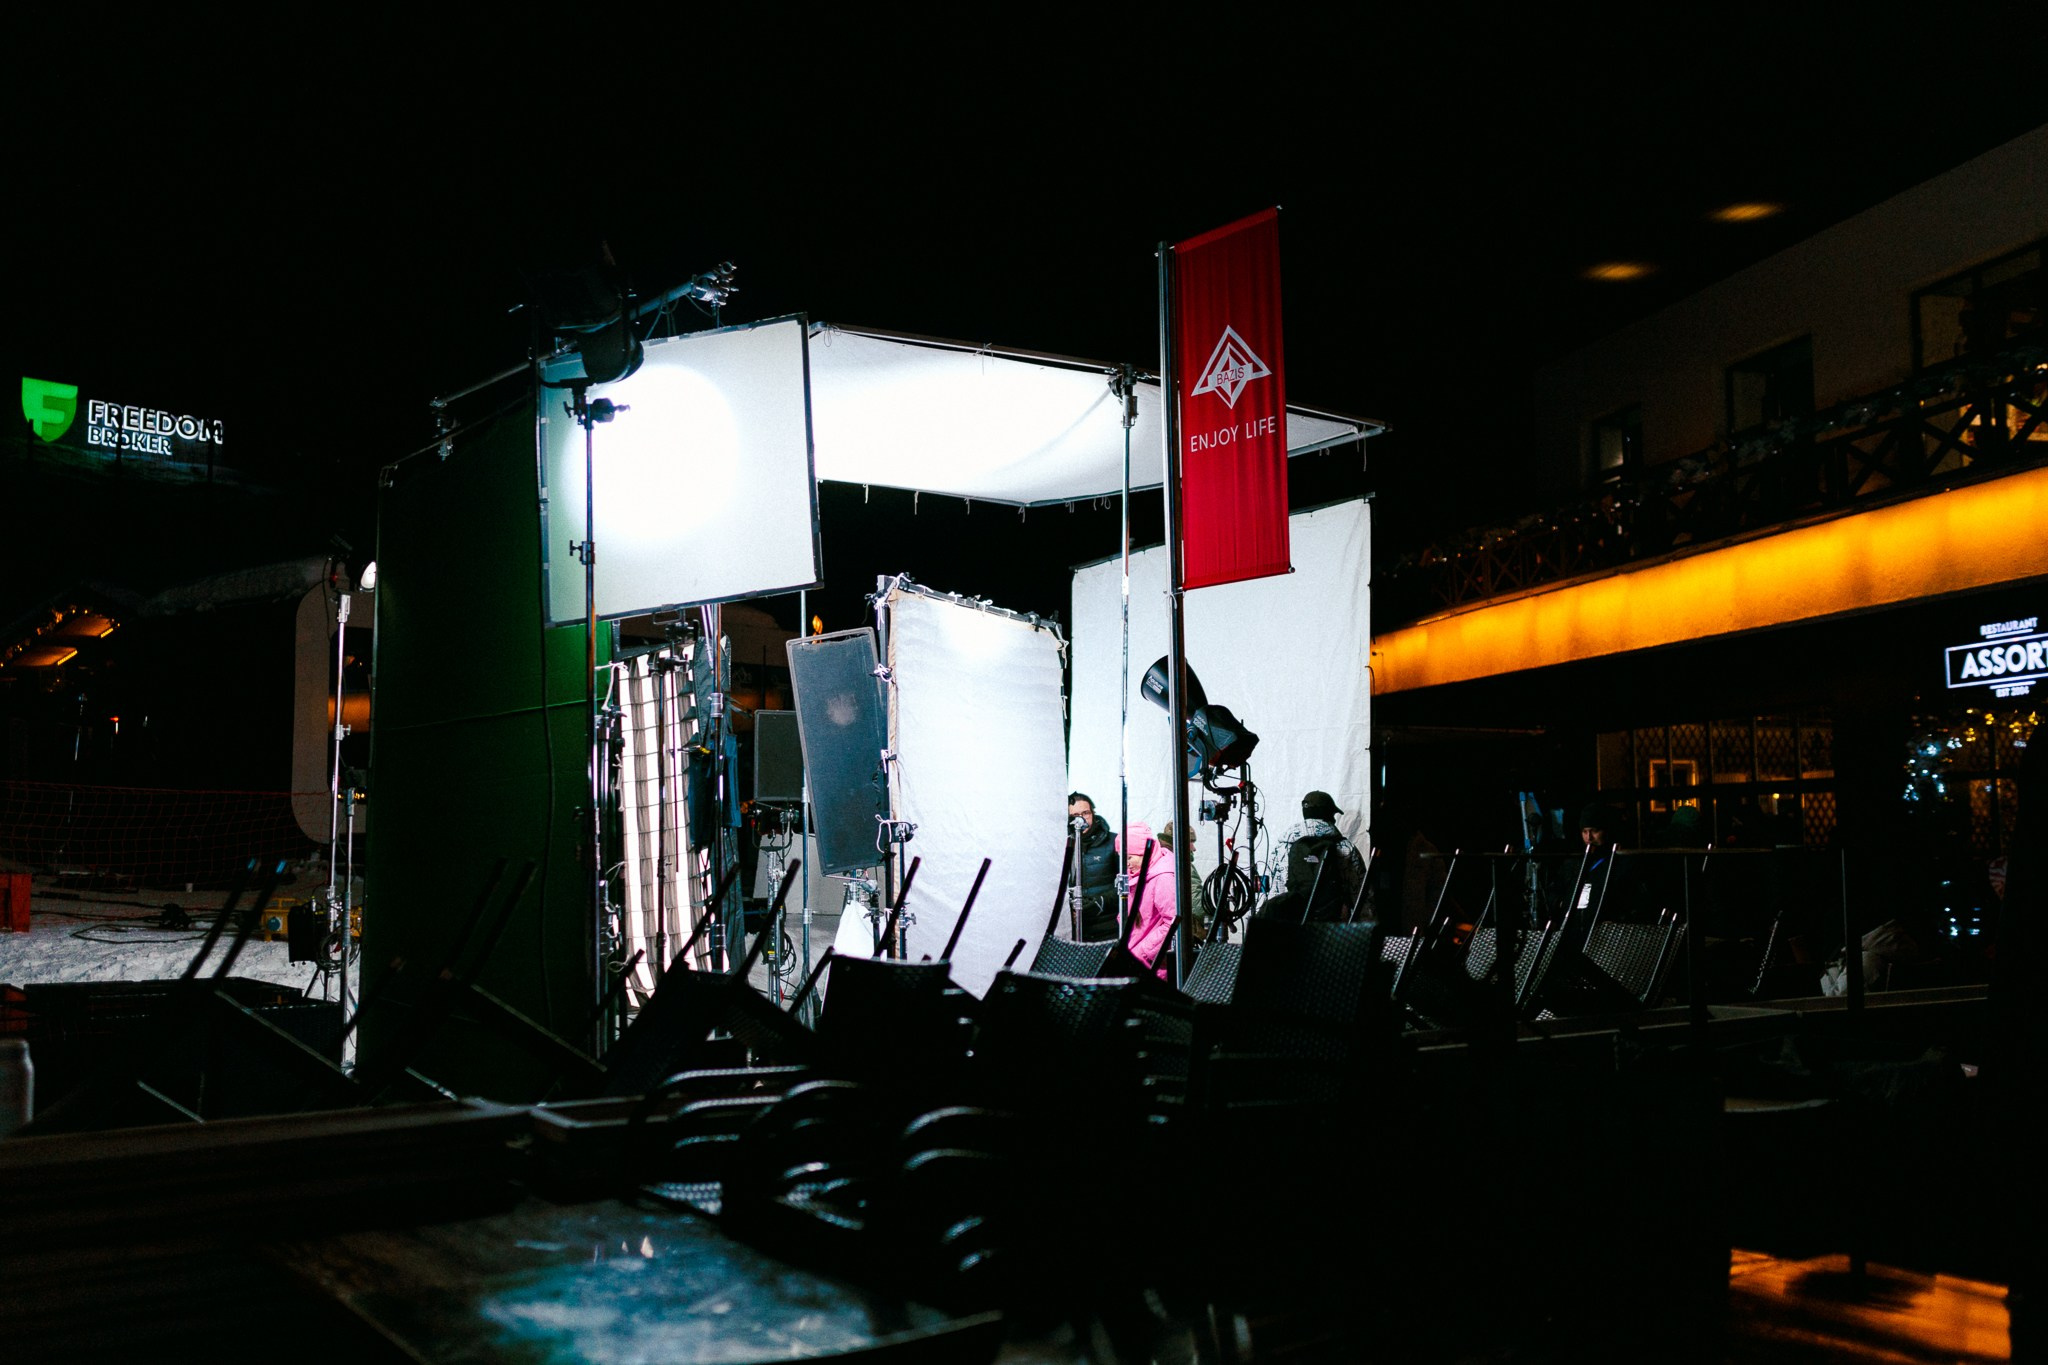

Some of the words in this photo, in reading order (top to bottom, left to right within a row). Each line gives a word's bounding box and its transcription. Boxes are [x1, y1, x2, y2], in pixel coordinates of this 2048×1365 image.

[1216, 366, 1245, 385] BAZIS
[88, 399, 224, 445] FREEDOM
[1190, 425, 1239, 453] ENJOY
[1245, 416, 1277, 439] LIFE
[87, 425, 173, 456] BROKER
[1980, 617, 2039, 636] RESTAURANT
[1996, 688, 2011, 698] EST
